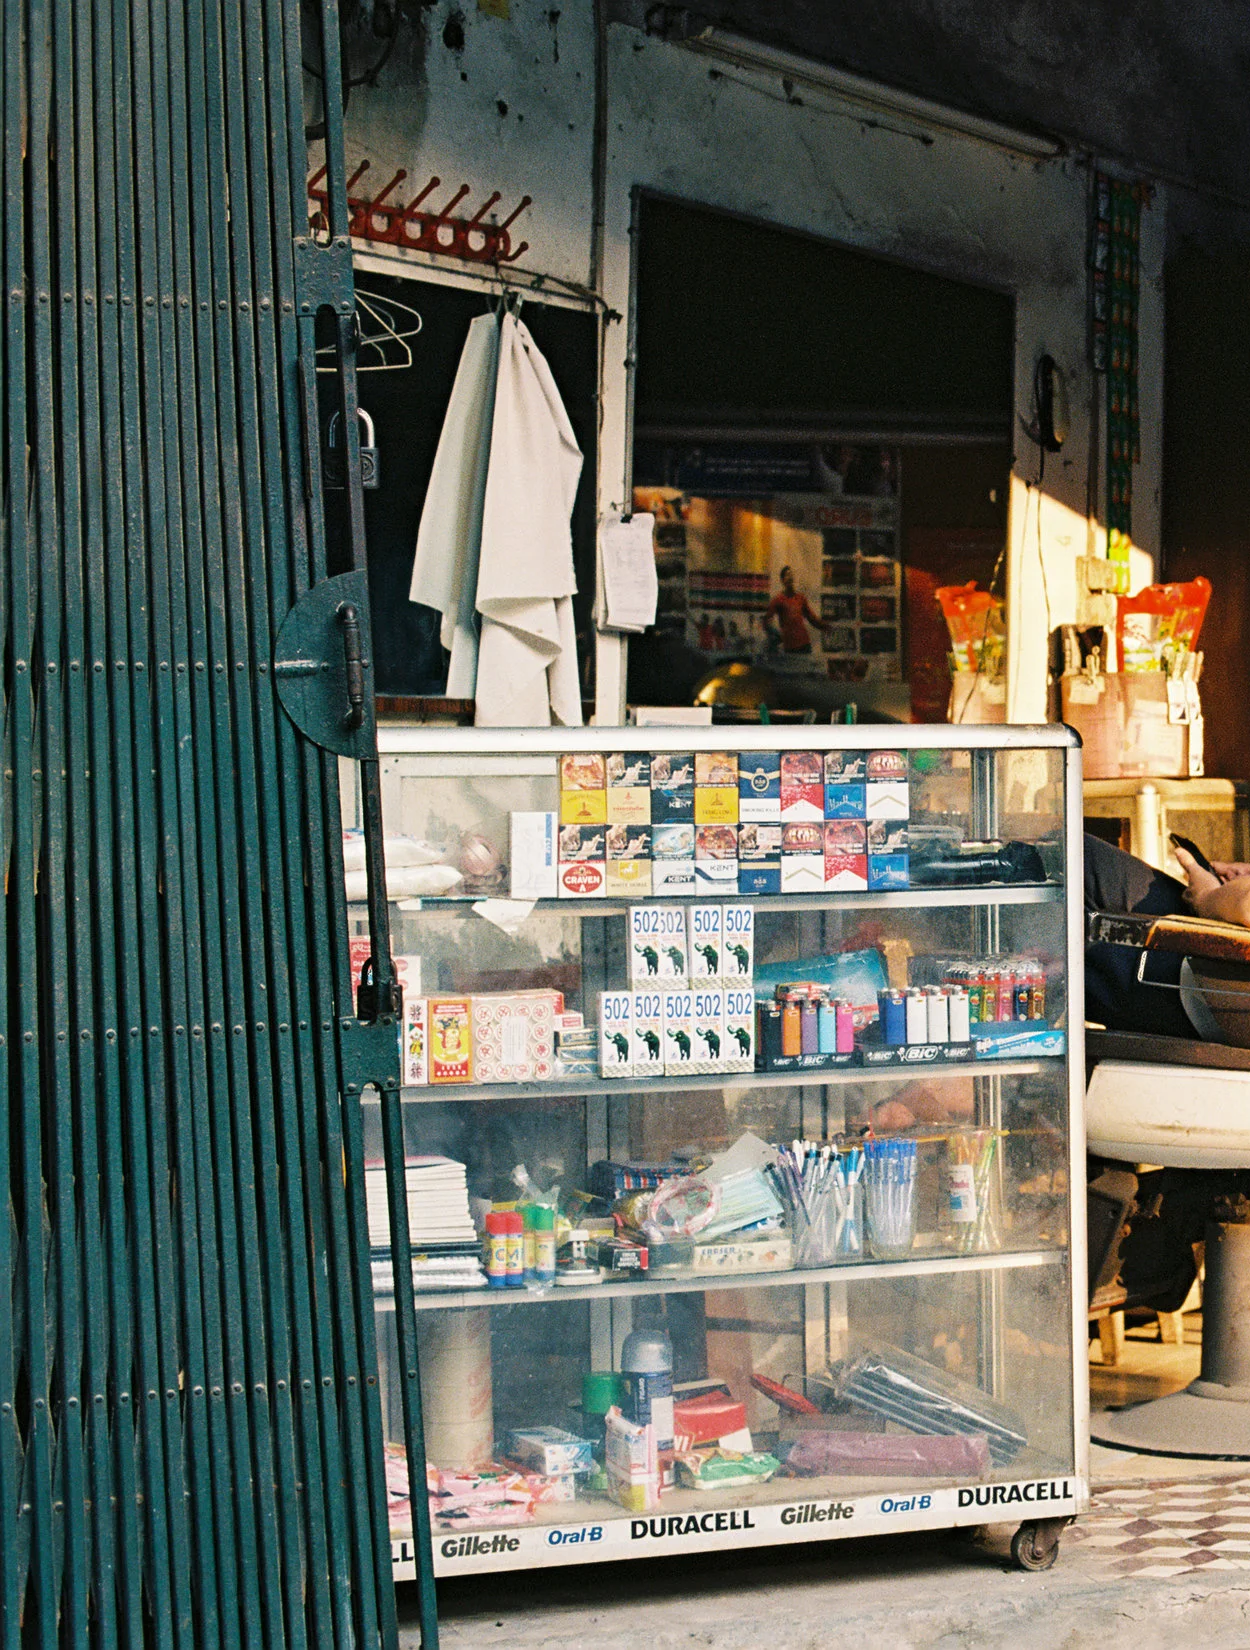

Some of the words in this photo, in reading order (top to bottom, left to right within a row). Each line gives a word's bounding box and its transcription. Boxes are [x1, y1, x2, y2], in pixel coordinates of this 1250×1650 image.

[669, 800, 692, 808] KENT
[564, 875, 600, 885] CRAVEN
[578, 884, 586, 892] A
[668, 875, 691, 883] KENT
[634, 911, 659, 933] 502
[694, 910, 720, 932] 502
[726, 909, 752, 932] 502
[604, 997, 630, 1020] 502
[635, 995, 661, 1018] 502
[666, 995, 692, 1018] 502
[695, 994, 721, 1016] 502
[727, 993, 753, 1015] 502
[803, 1055, 826, 1065] BIC
[907, 1048, 936, 1059] BIC
[440, 1535, 520, 1558] Gillette
[548, 1526, 603, 1546] Oral-B
[630, 1510, 756, 1541] DURACELL
[780, 1502, 855, 1526] Gillette
[880, 1495, 931, 1513] Oral-B
[957, 1480, 1074, 1508] DURACELL
